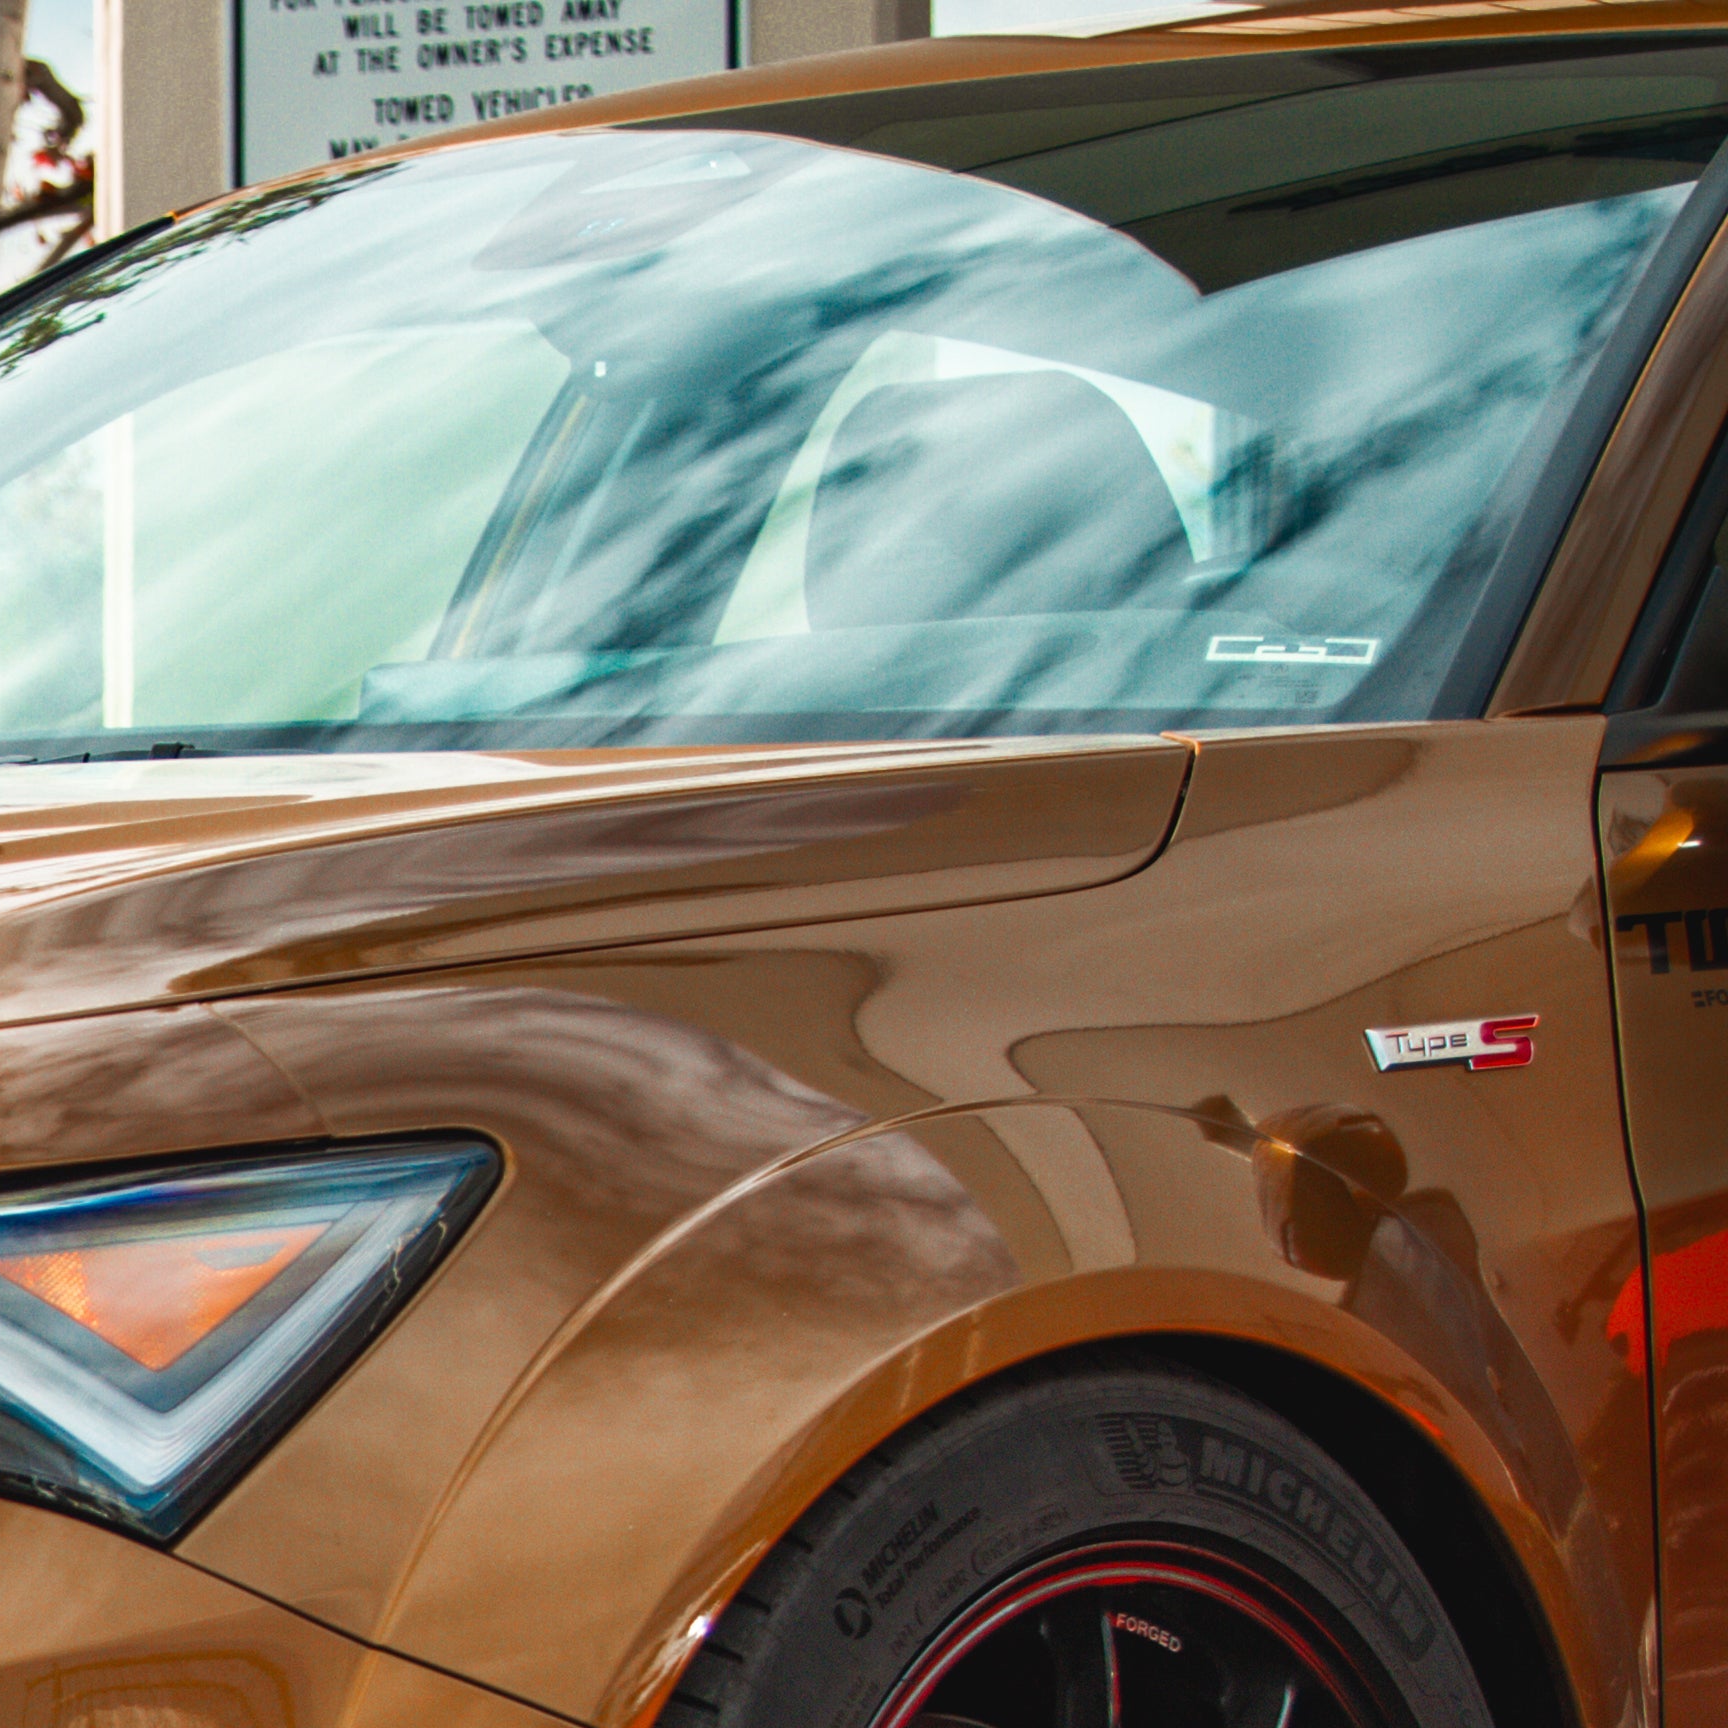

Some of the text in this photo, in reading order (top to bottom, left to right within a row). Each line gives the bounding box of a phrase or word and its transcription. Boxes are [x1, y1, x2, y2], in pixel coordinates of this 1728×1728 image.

[344, 0, 623, 39] WILL BE TOWED AWAY
[312, 27, 655, 75] AT THE OWNER'S EXPENSE
[373, 94, 455, 125] TOWED
[1385, 1013, 1541, 1072] Type S
[861, 1501, 939, 1590] MICHELIN
[1199, 1435, 1419, 1643] MICHELIN
[1115, 1612, 1183, 1653] FORGED
